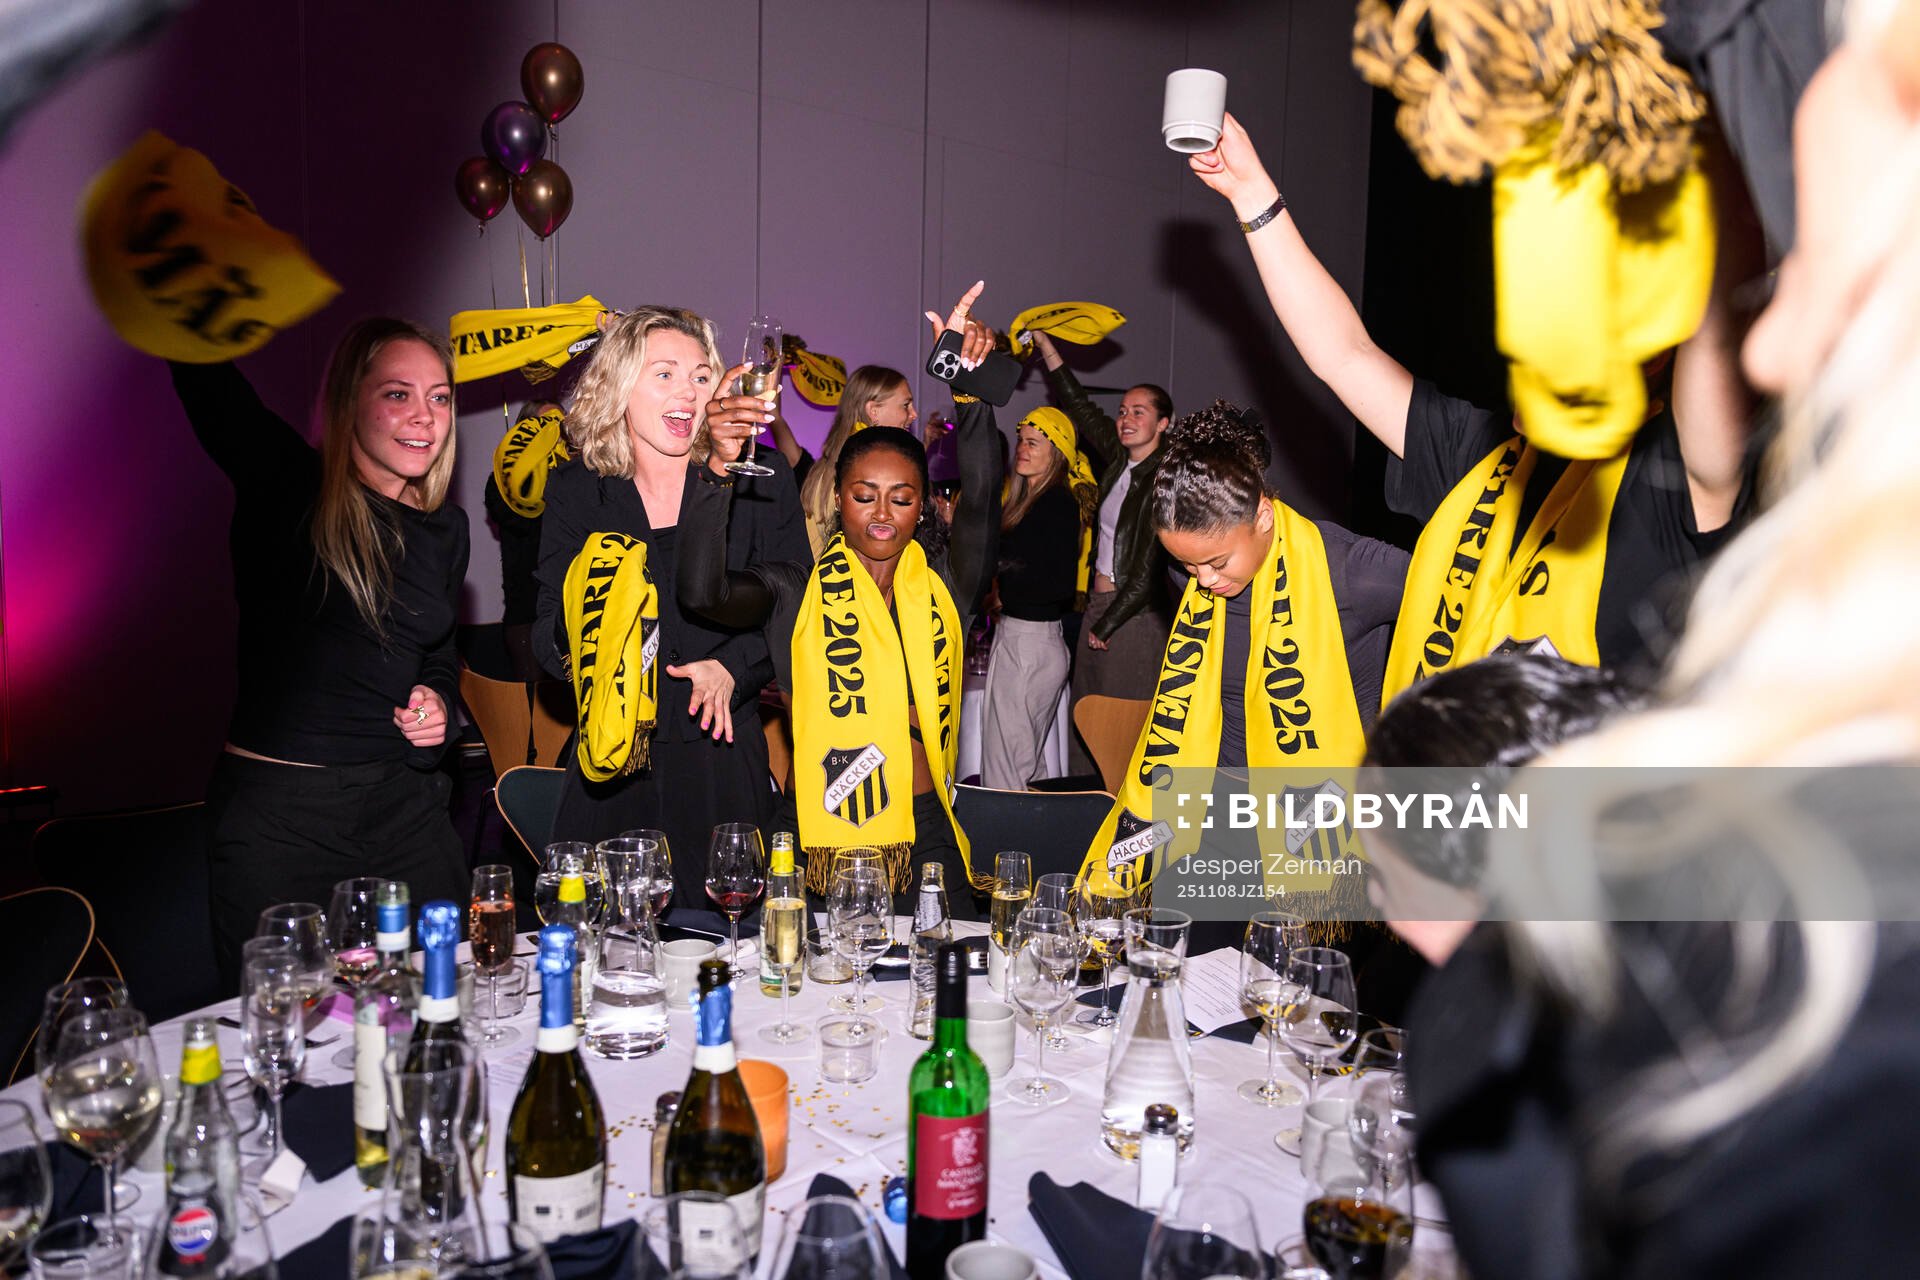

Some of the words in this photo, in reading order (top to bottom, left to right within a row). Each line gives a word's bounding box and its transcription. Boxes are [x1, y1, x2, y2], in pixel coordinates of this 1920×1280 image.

[452, 325, 534, 356] TARE
[502, 421, 540, 472] TARE
[823, 612, 868, 718] 2025
[1263, 638, 1320, 755] 2025
[829, 752, 880, 802] HÄCKEN
[1113, 828, 1166, 860] HÄCKEN
